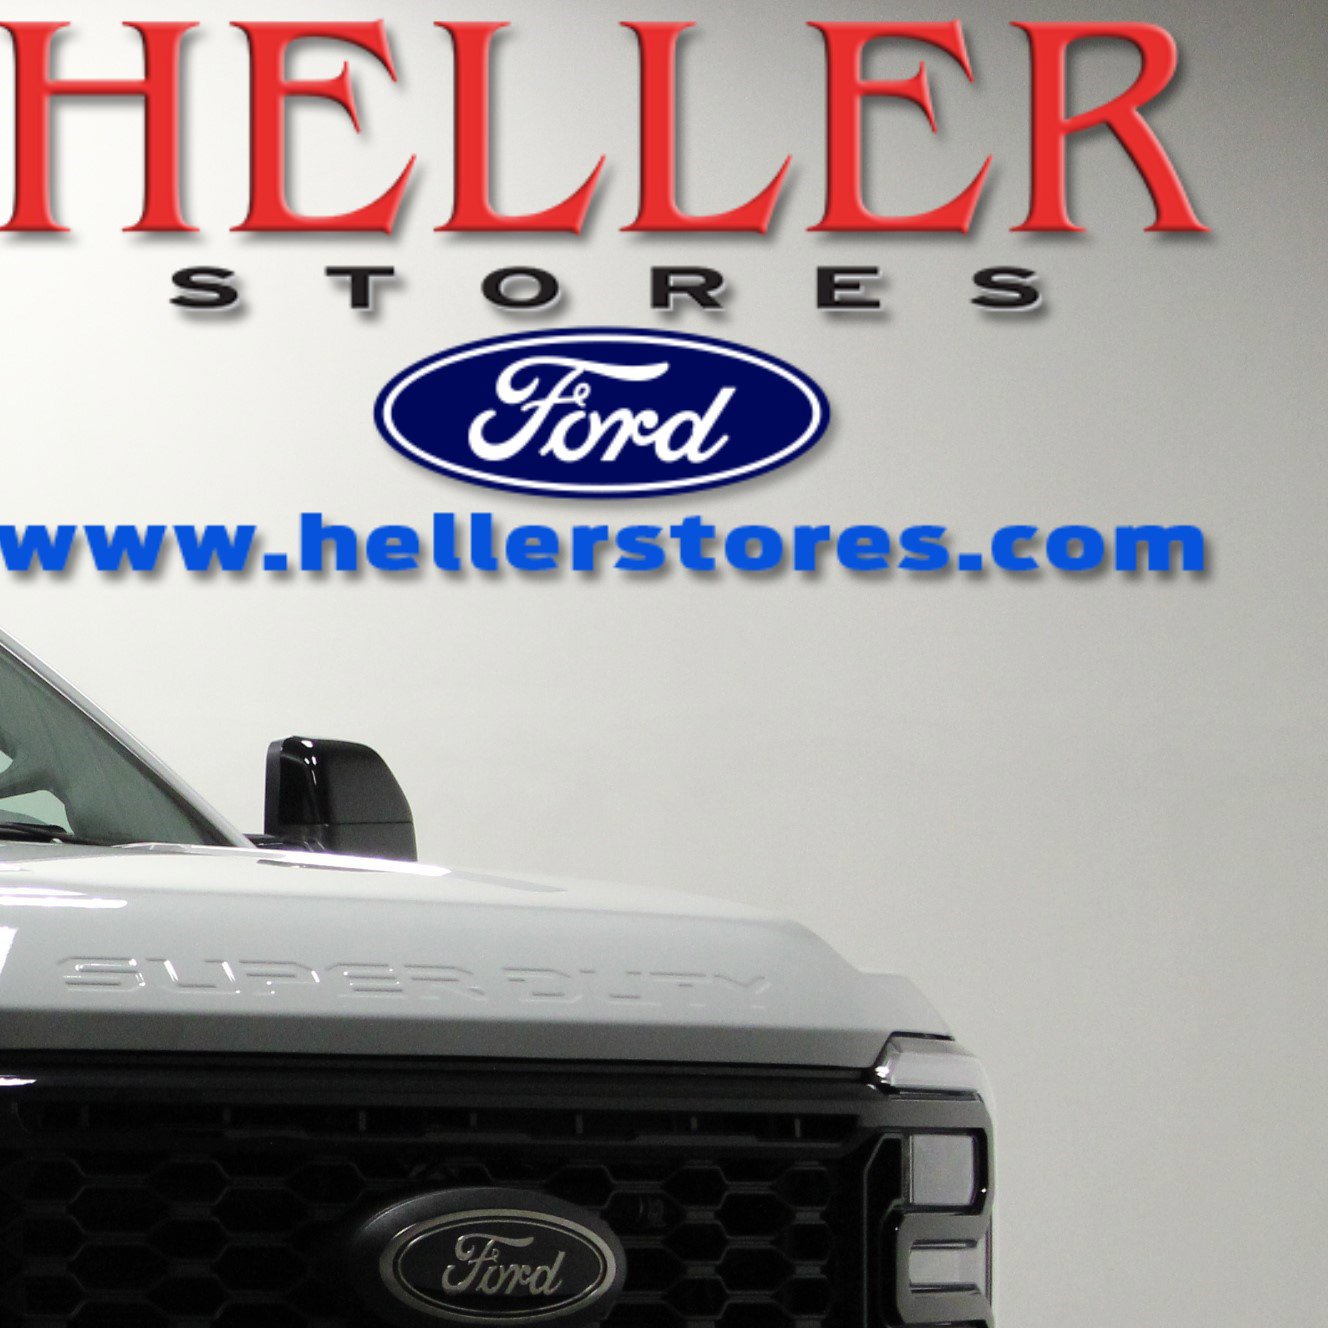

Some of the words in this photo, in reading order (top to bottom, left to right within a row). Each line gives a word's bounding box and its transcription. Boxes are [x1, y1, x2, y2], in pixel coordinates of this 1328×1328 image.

[56, 956, 486, 999] SUPER
[500, 966, 770, 1009] DUTY
[441, 1232, 566, 1296] Ford
